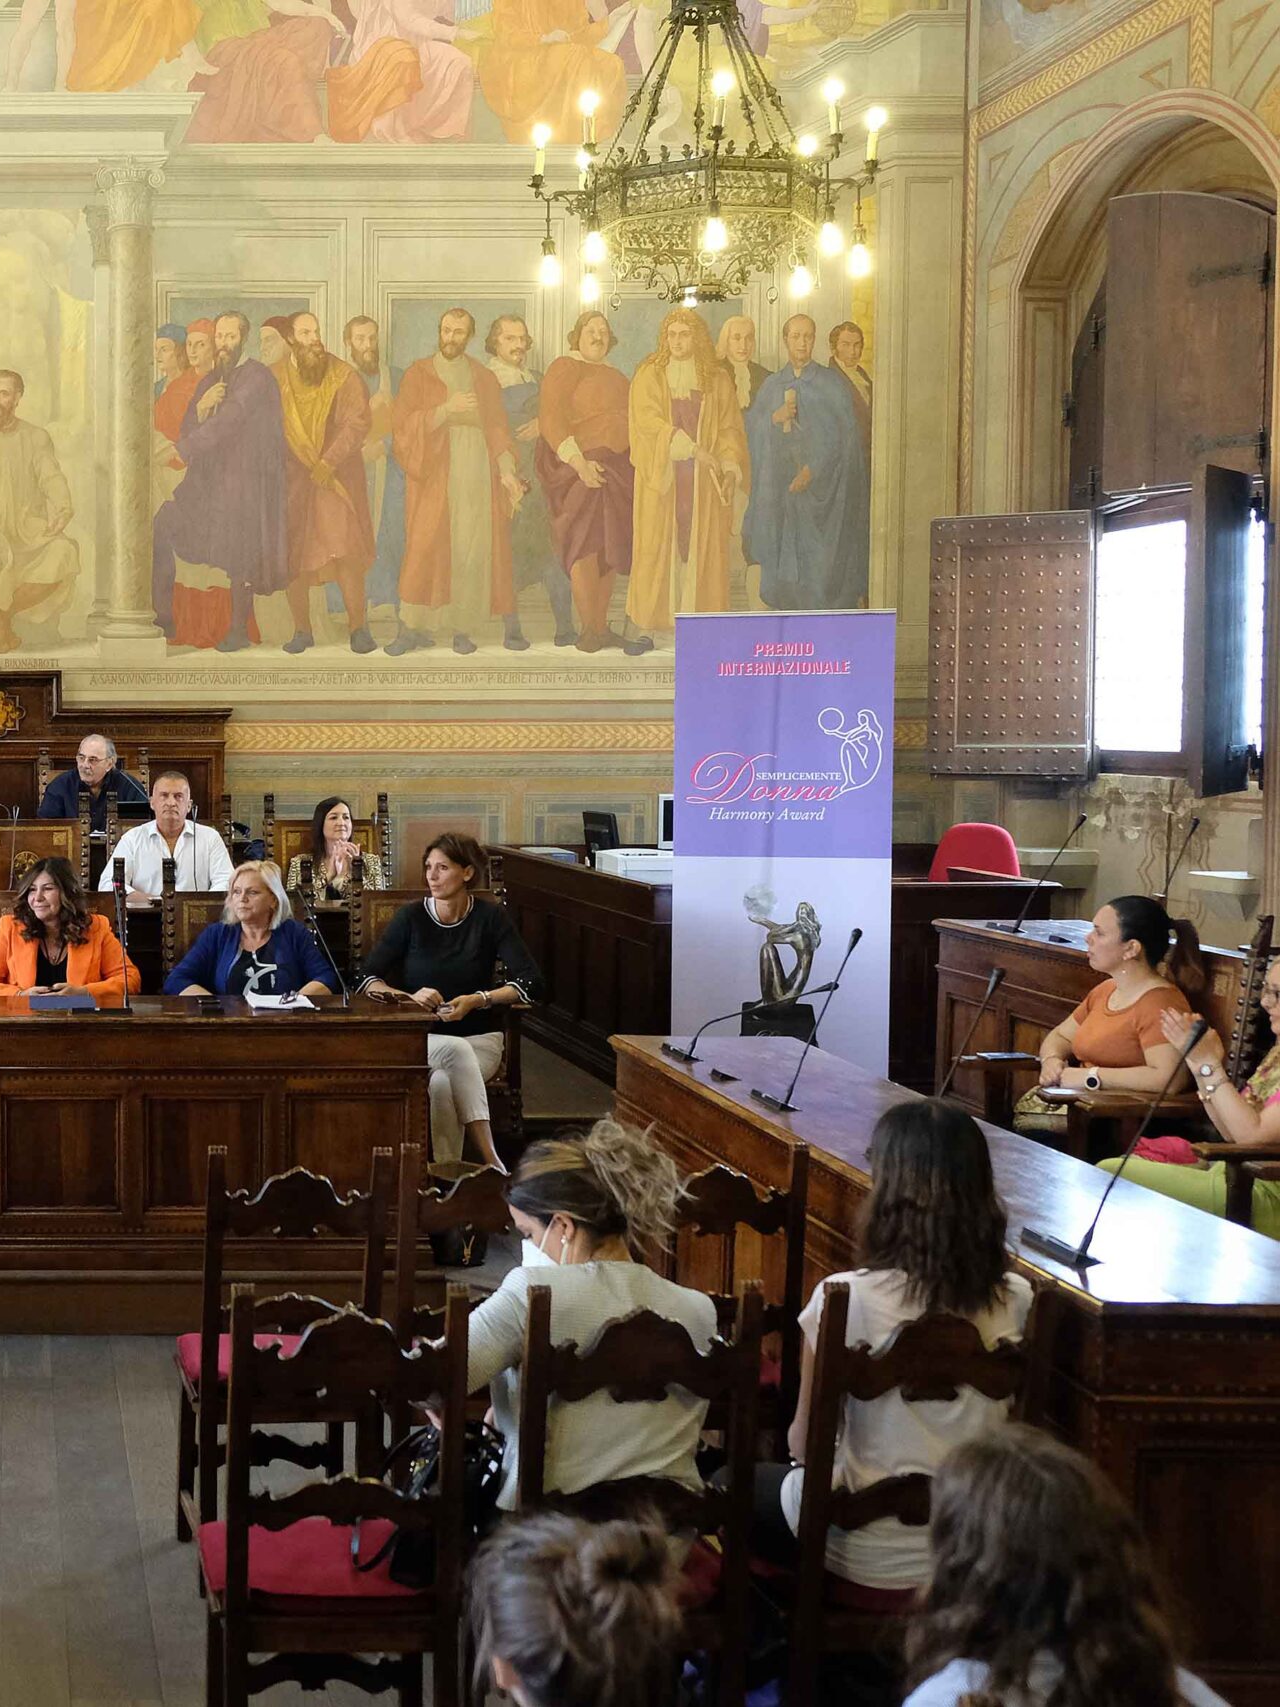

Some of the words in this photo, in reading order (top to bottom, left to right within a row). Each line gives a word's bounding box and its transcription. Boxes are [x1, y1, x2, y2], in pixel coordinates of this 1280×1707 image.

[753, 642, 814, 657] PREMIO
[717, 661, 851, 676] INTERNAZIONALE
[686, 752, 841, 804] Donna
[756, 772, 842, 781] SEMPLICEMENTE
[708, 807, 775, 823] Harmony
[777, 807, 825, 821] Award
